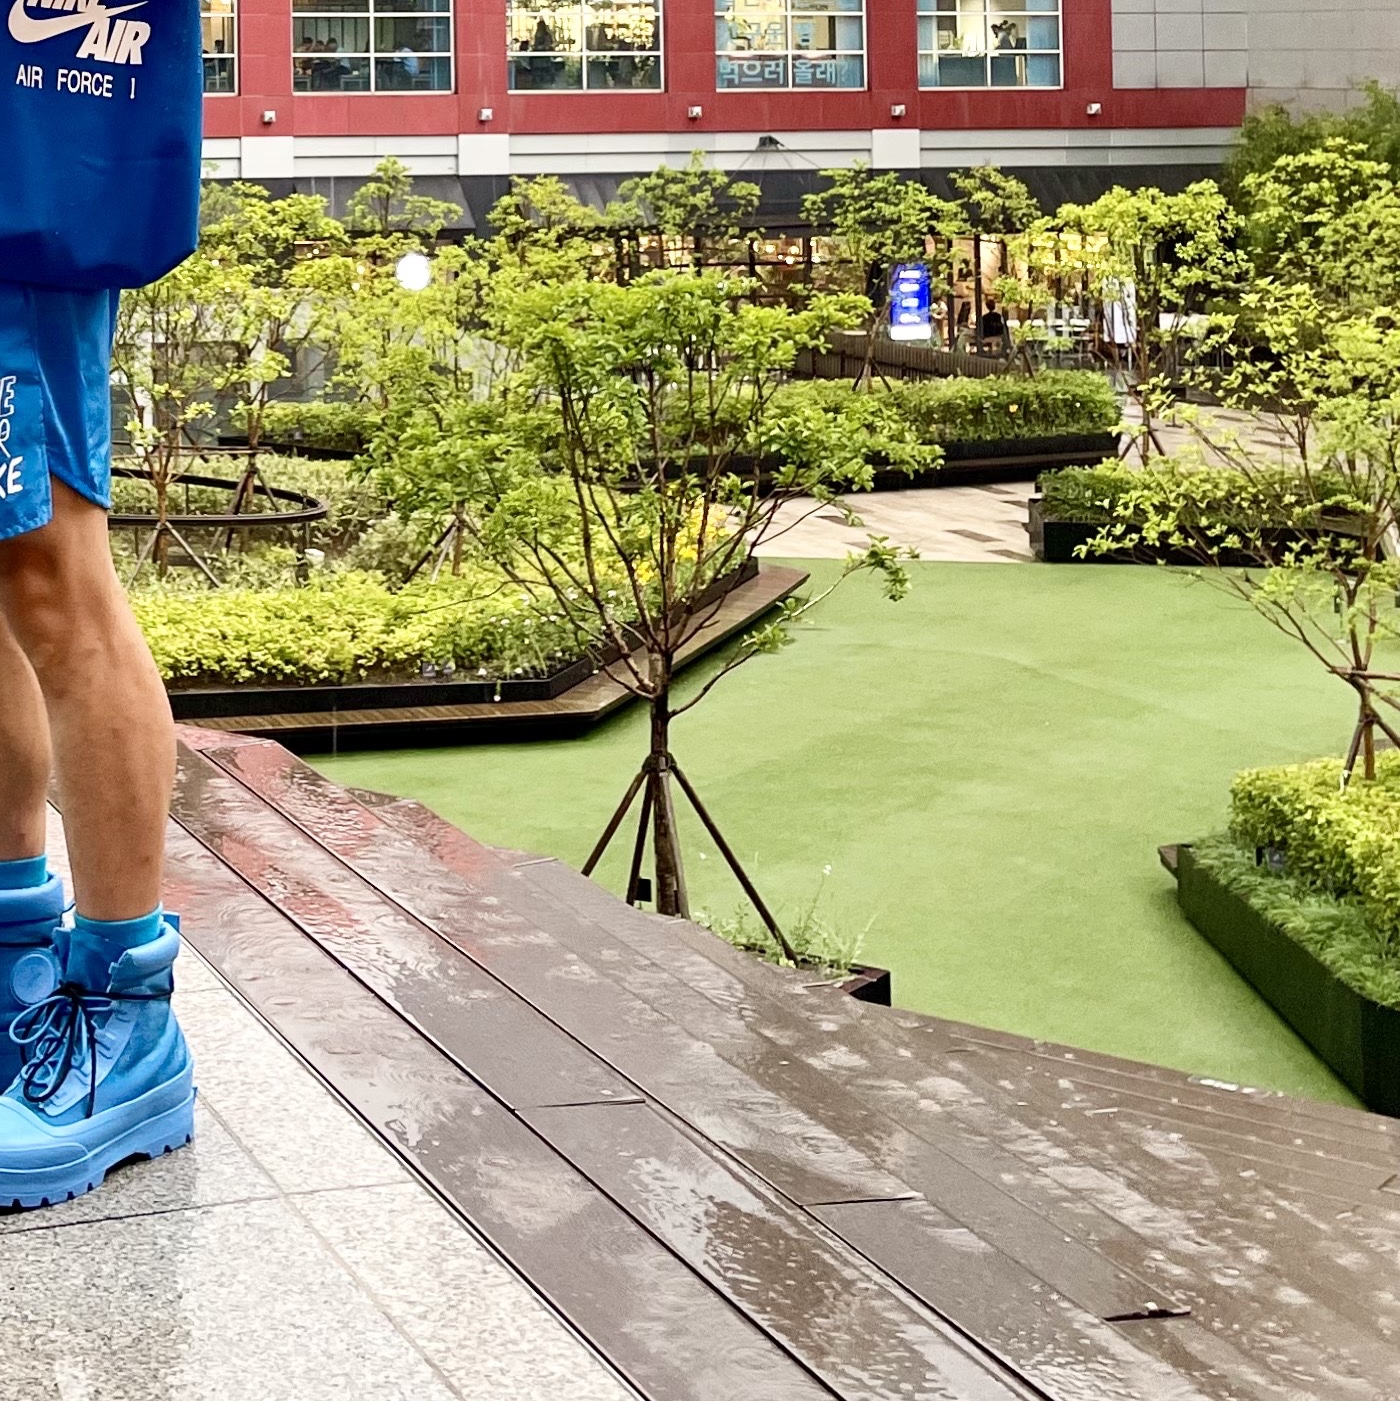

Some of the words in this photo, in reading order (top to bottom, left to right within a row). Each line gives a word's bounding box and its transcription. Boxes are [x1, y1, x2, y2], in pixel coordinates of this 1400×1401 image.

[76, 17, 151, 65] AIR
[15, 64, 43, 89] AIR
[57, 69, 113, 98] FORCE
[719, 59, 784, 85] 먹으러
